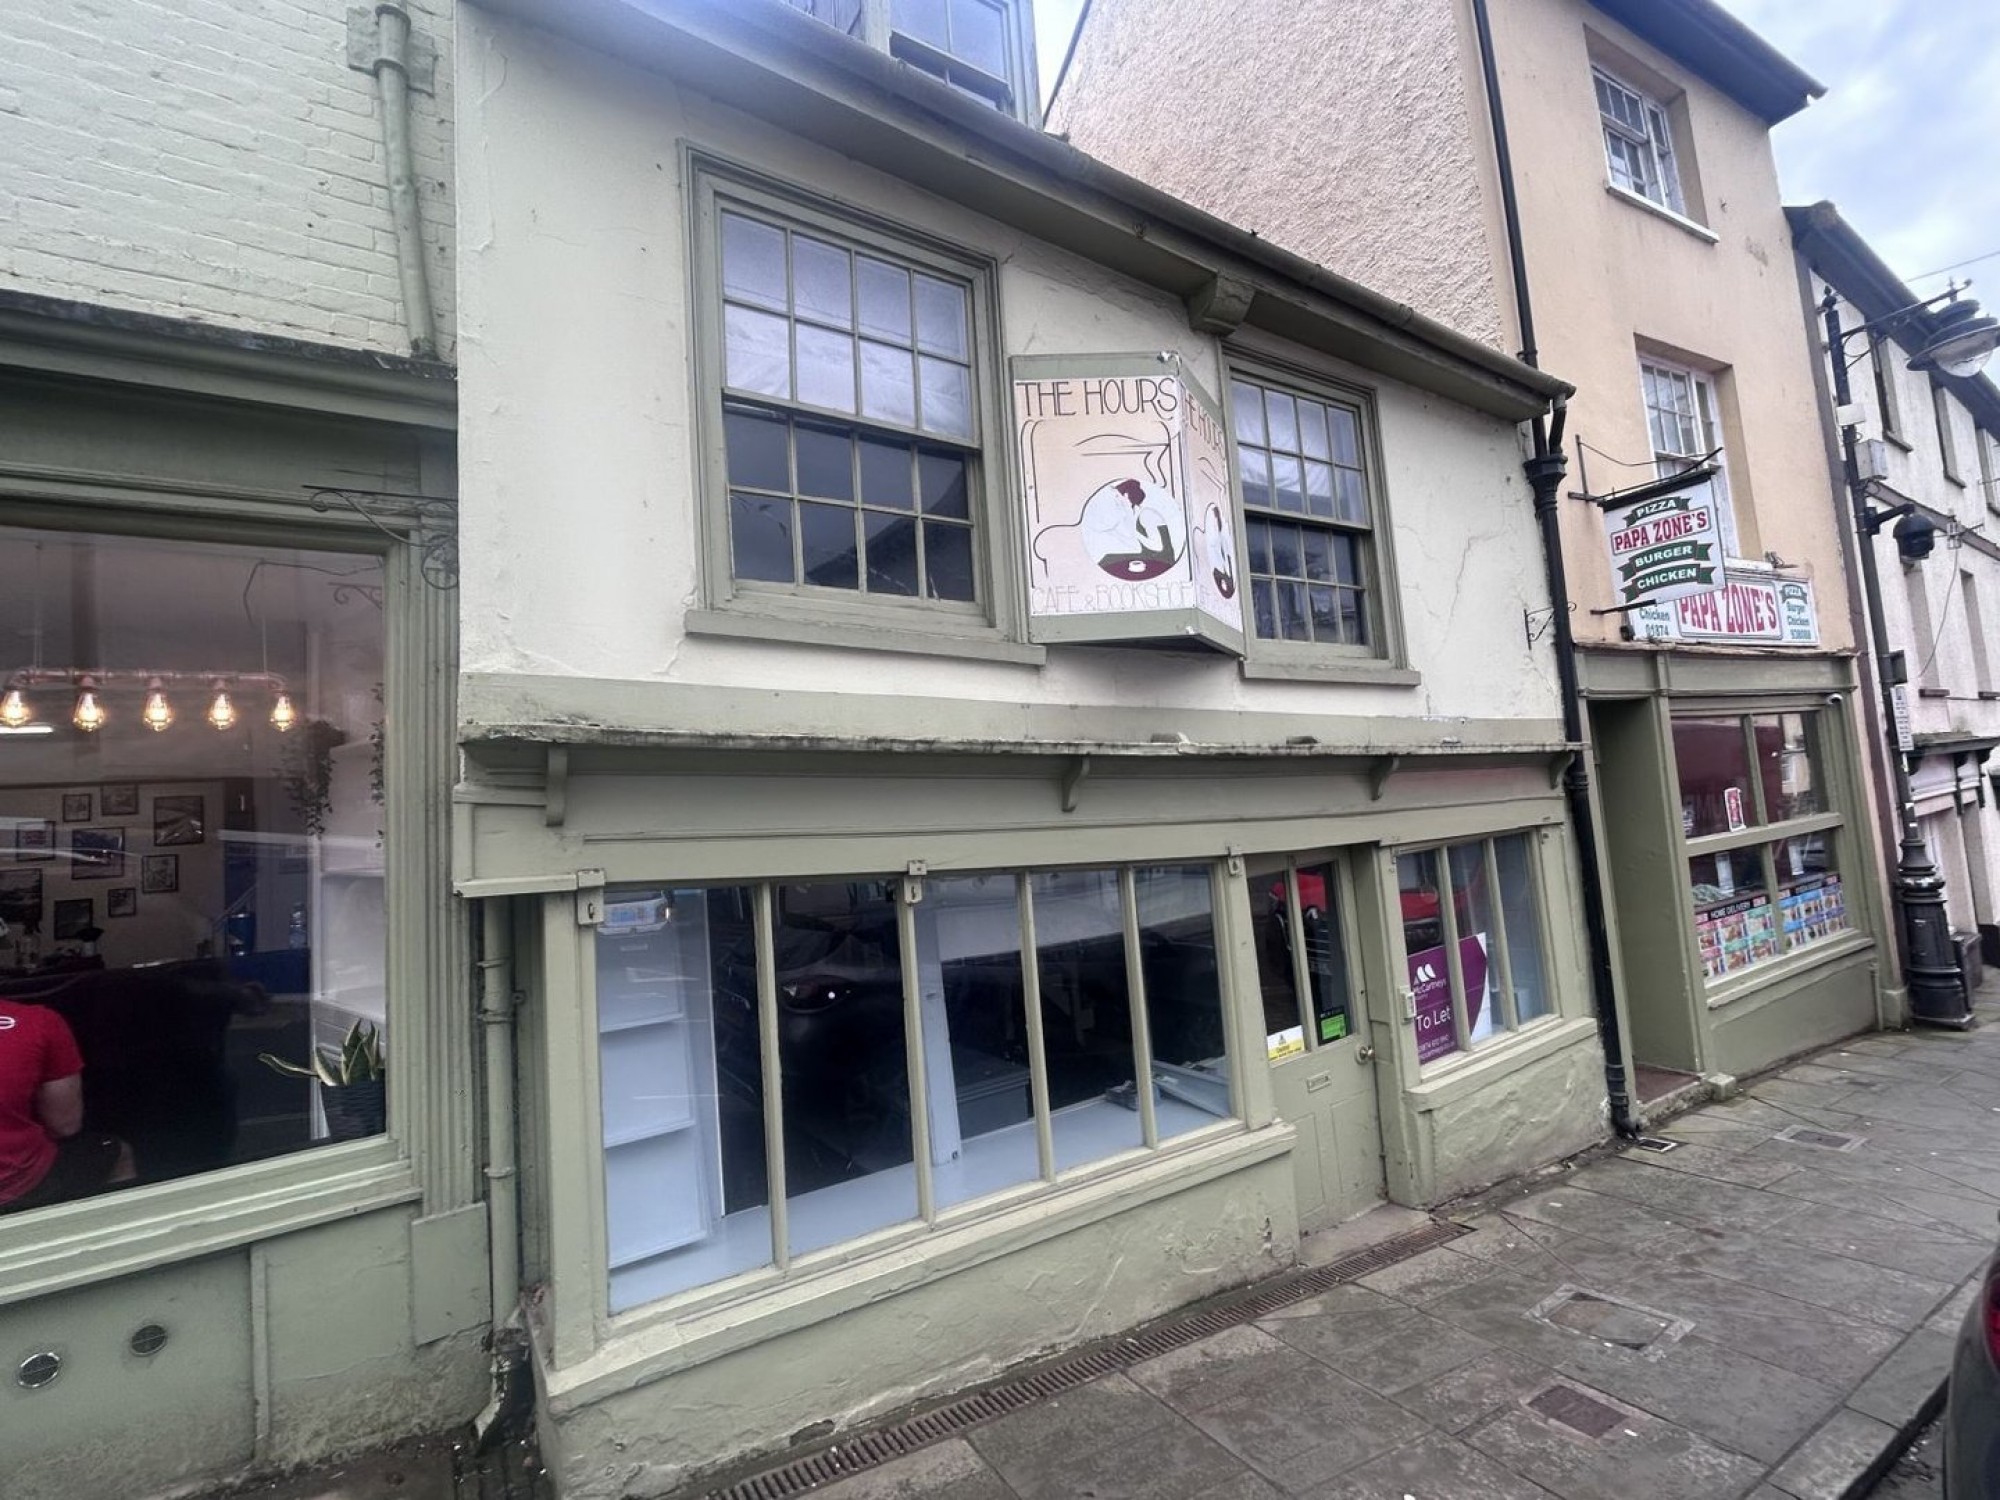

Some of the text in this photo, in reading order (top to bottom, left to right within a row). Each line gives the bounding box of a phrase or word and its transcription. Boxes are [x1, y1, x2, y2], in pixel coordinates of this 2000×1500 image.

[1016, 377, 1179, 421] THE HOURS
[1636, 499, 1677, 518] PIZZA
[1614, 511, 1707, 551] PAPA ZONE'S
[1635, 545, 1693, 568] BURGER
[1637, 567, 1697, 590] CHICKEN
[1680, 584, 1777, 633] PAPA ZONE'S
[1416, 1004, 1451, 1032] To Let
